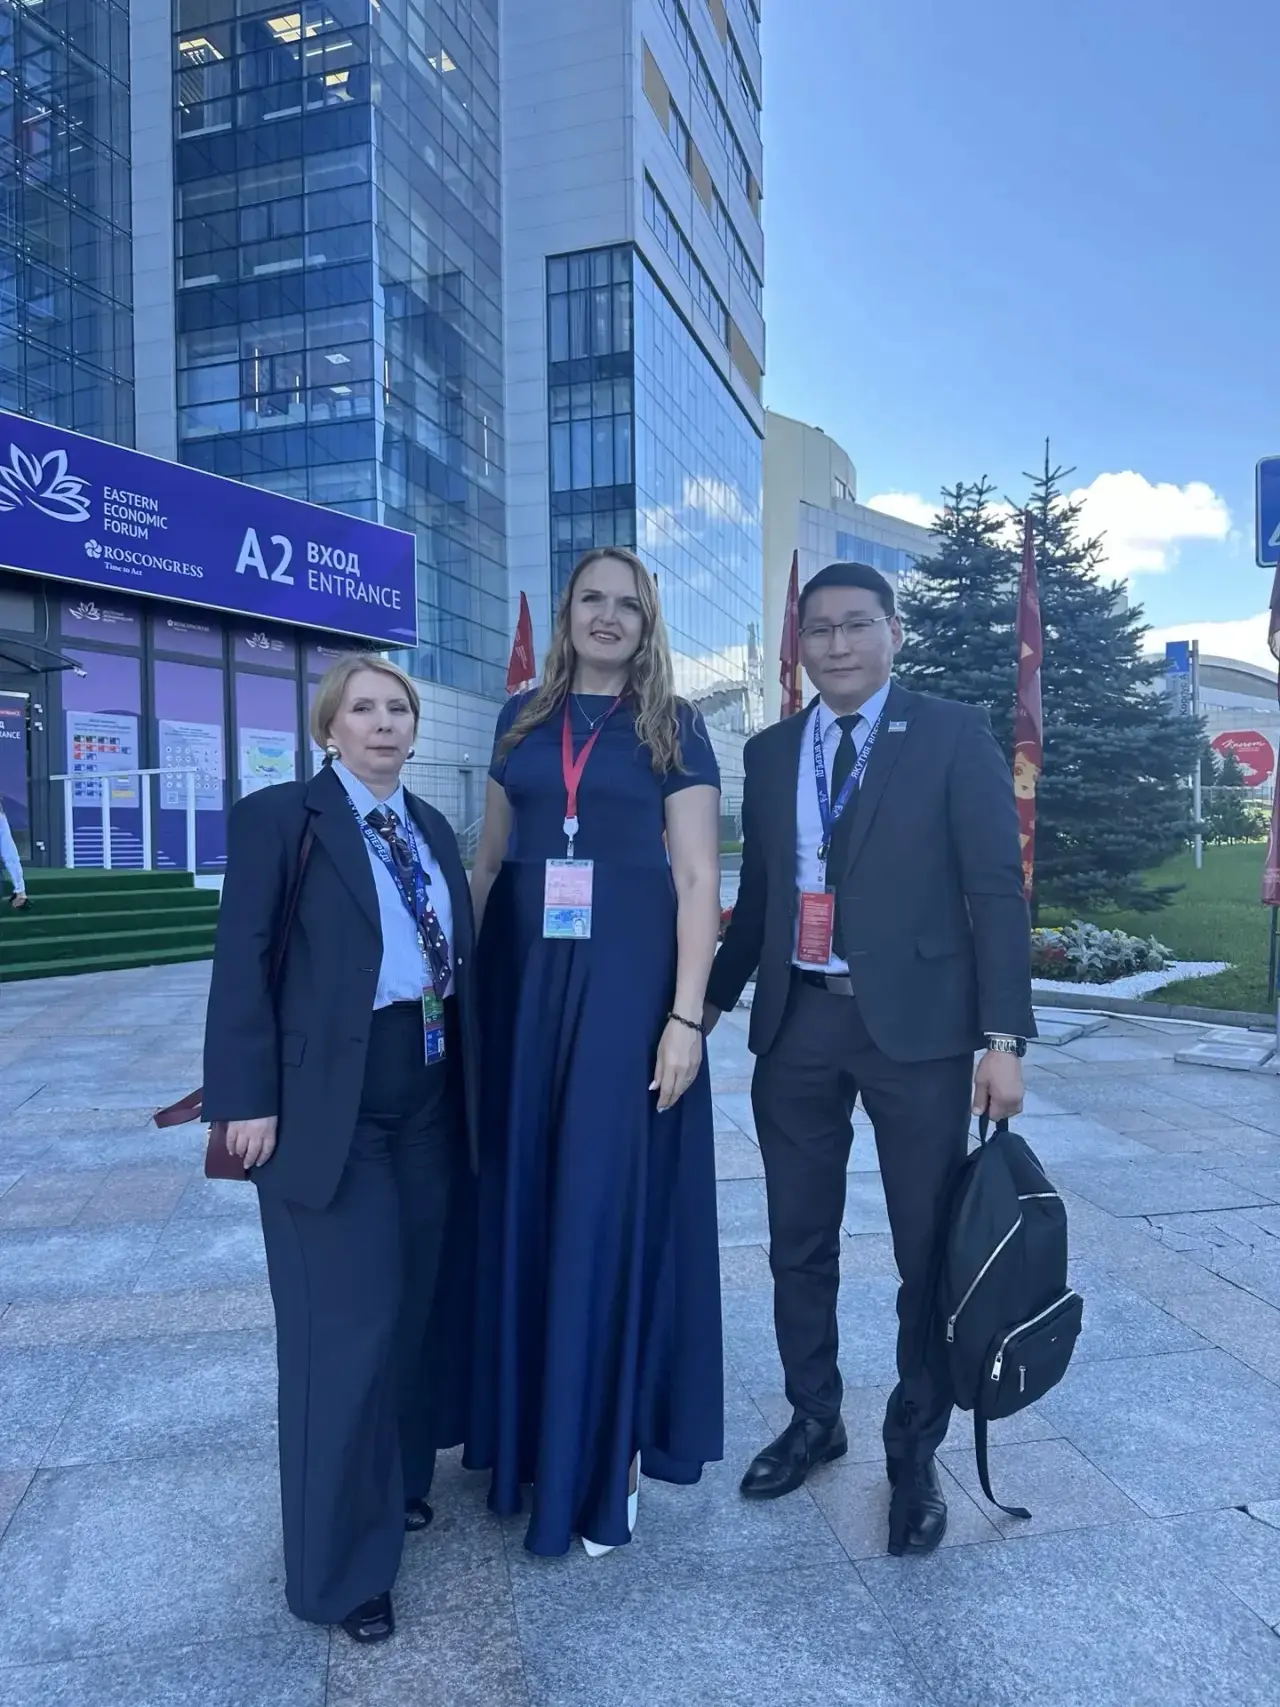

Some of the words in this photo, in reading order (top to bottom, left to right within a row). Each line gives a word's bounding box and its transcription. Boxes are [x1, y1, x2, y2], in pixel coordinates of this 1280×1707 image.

[103, 485, 159, 512] EASTERN
[103, 502, 168, 530] ECONOMIC
[104, 518, 149, 540] FORUM
[103, 545, 204, 578] ROSCONGRESS
[104, 561, 122, 572] Time
[123, 566, 130, 574] to
[131, 567, 143, 576] Act
[235, 527, 295, 586] A2
[307, 541, 361, 577] ВХОД
[308, 569, 402, 610] ENTRANCE
[364, 829, 391, 863] ВПЕРЕД!
